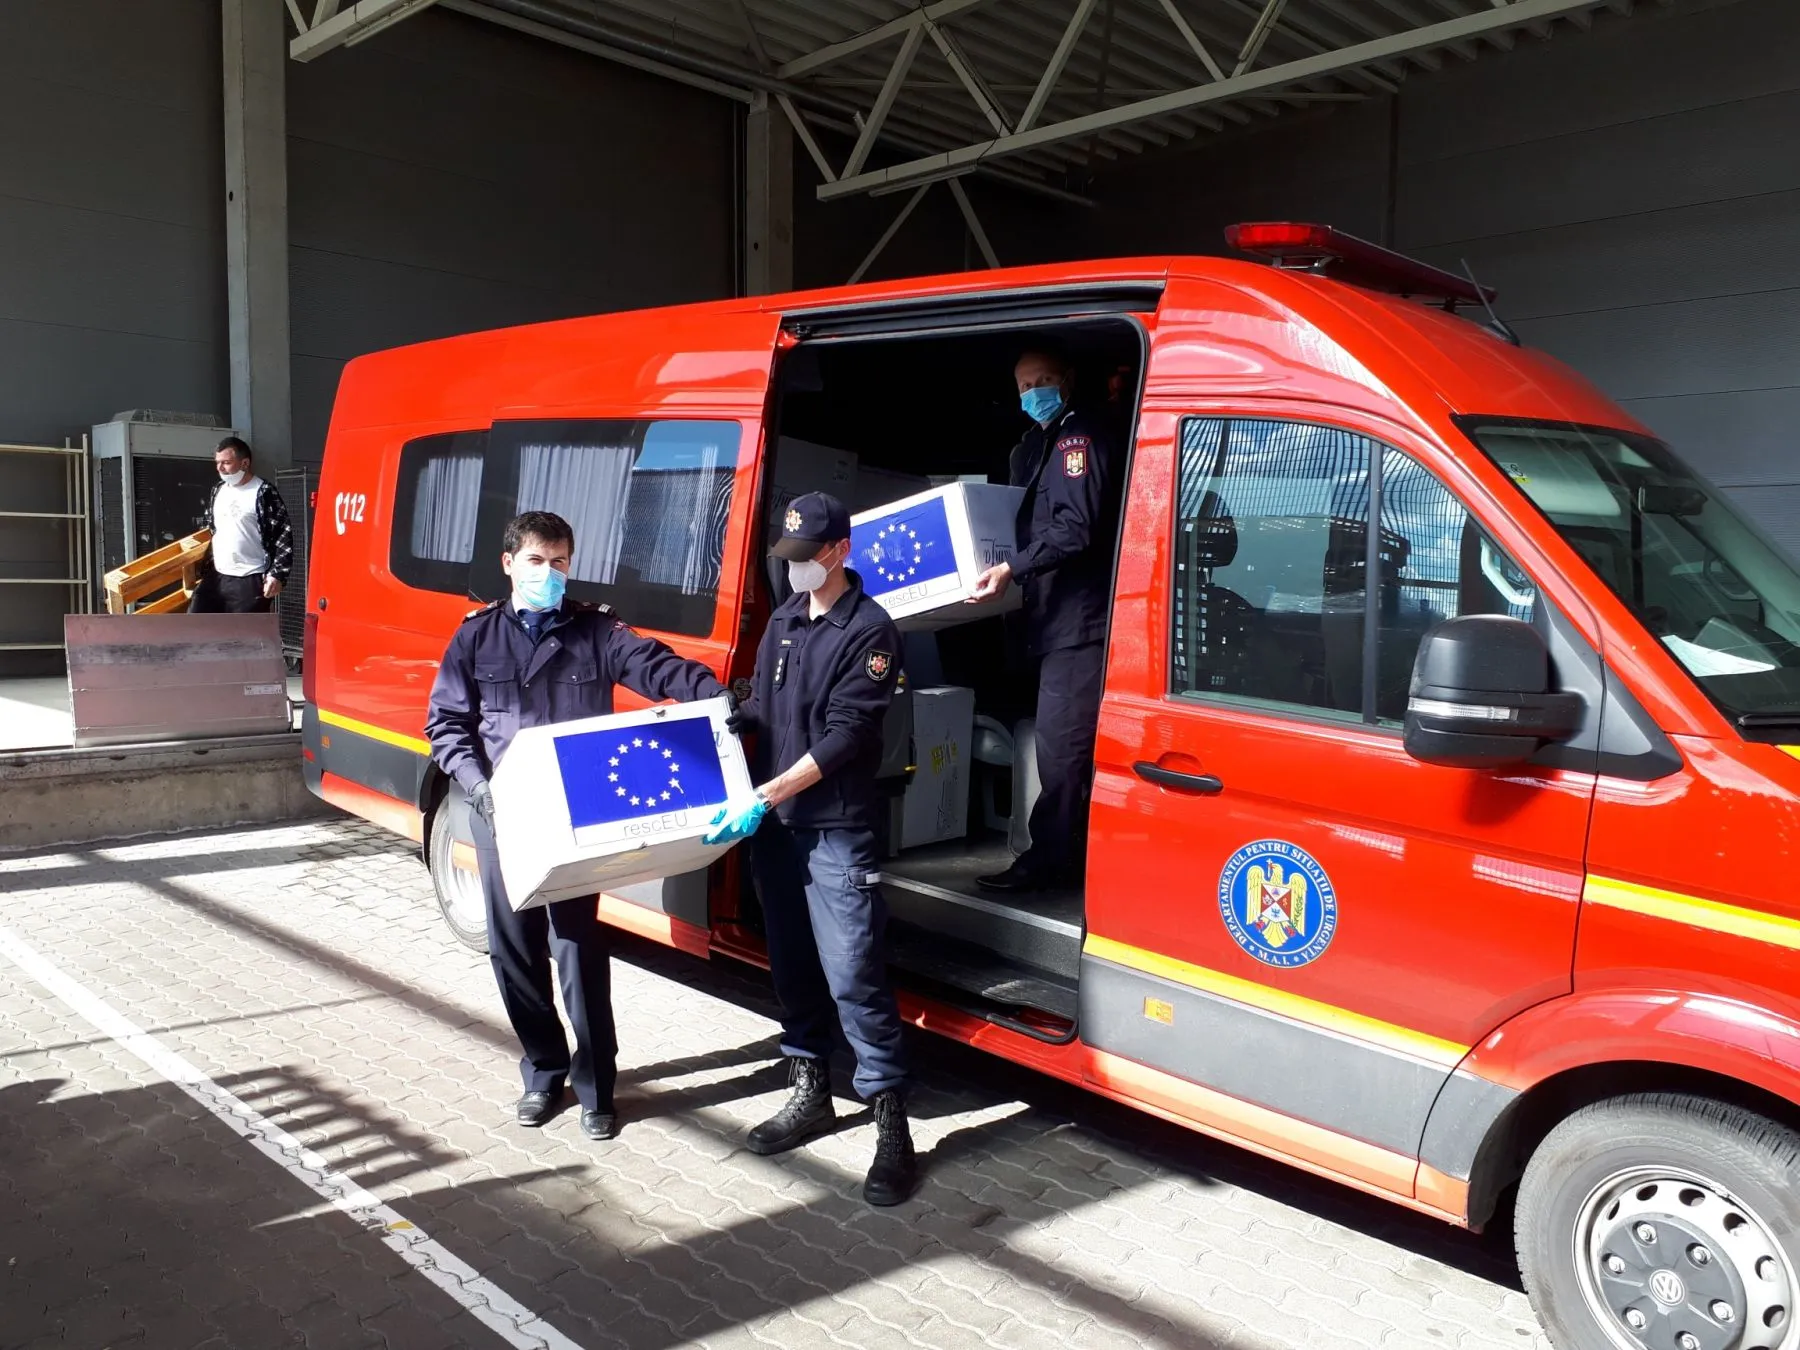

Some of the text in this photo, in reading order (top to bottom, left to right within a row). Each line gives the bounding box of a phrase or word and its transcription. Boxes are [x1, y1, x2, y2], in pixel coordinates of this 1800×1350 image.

[343, 492, 366, 522] 112
[884, 583, 928, 607] rescEU
[623, 811, 688, 837] rescEU
[1220, 853, 1247, 946] DEPARTAMENTUL
[1245, 842, 1289, 856] PENTRU
[1324, 894, 1335, 912] DE
[1257, 950, 1290, 966] M.A.I.
